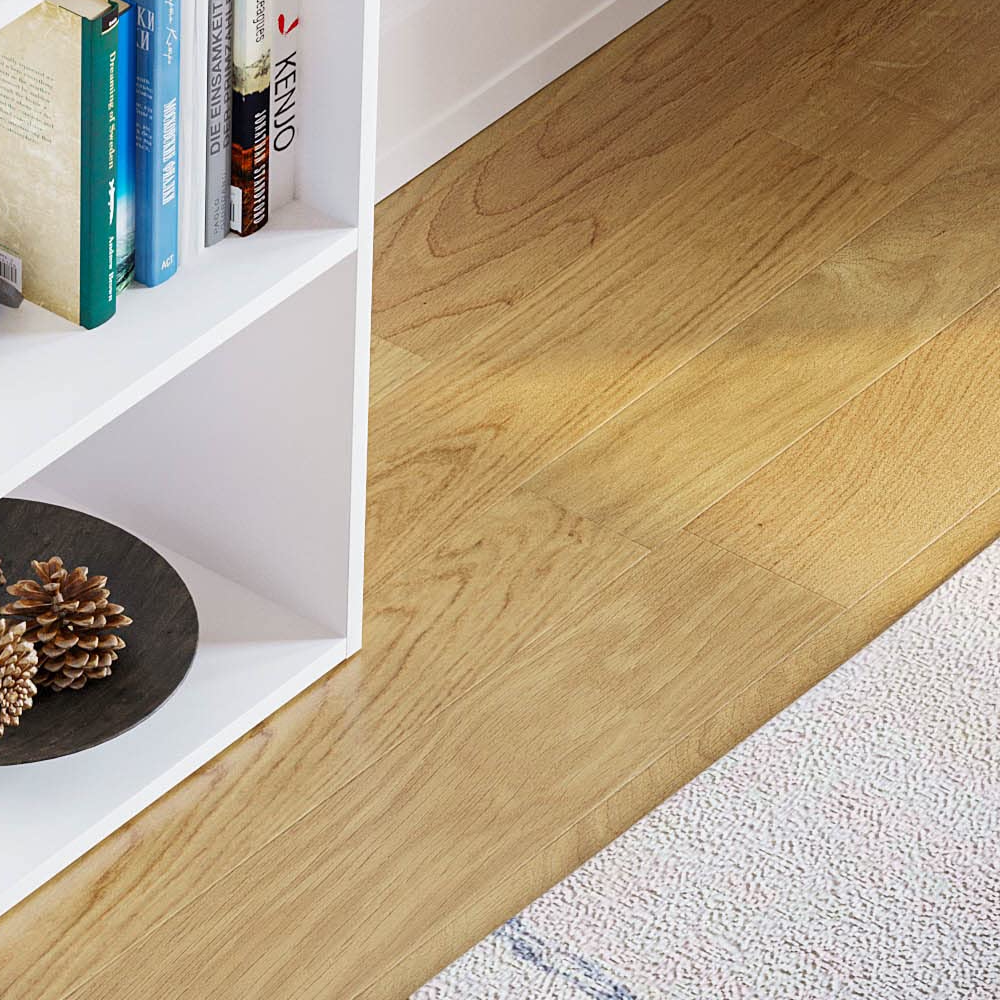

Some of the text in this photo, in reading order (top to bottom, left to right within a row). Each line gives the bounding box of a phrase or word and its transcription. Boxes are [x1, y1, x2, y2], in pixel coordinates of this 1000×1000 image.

[108, 50, 116, 111] Dreaming
[109, 111, 115, 122] of
[210, 2, 223, 156] DIE EINSAMKEIT
[274, 51, 297, 152] KENJO
[254, 110, 266, 224] JONATHAN STANDFORD
